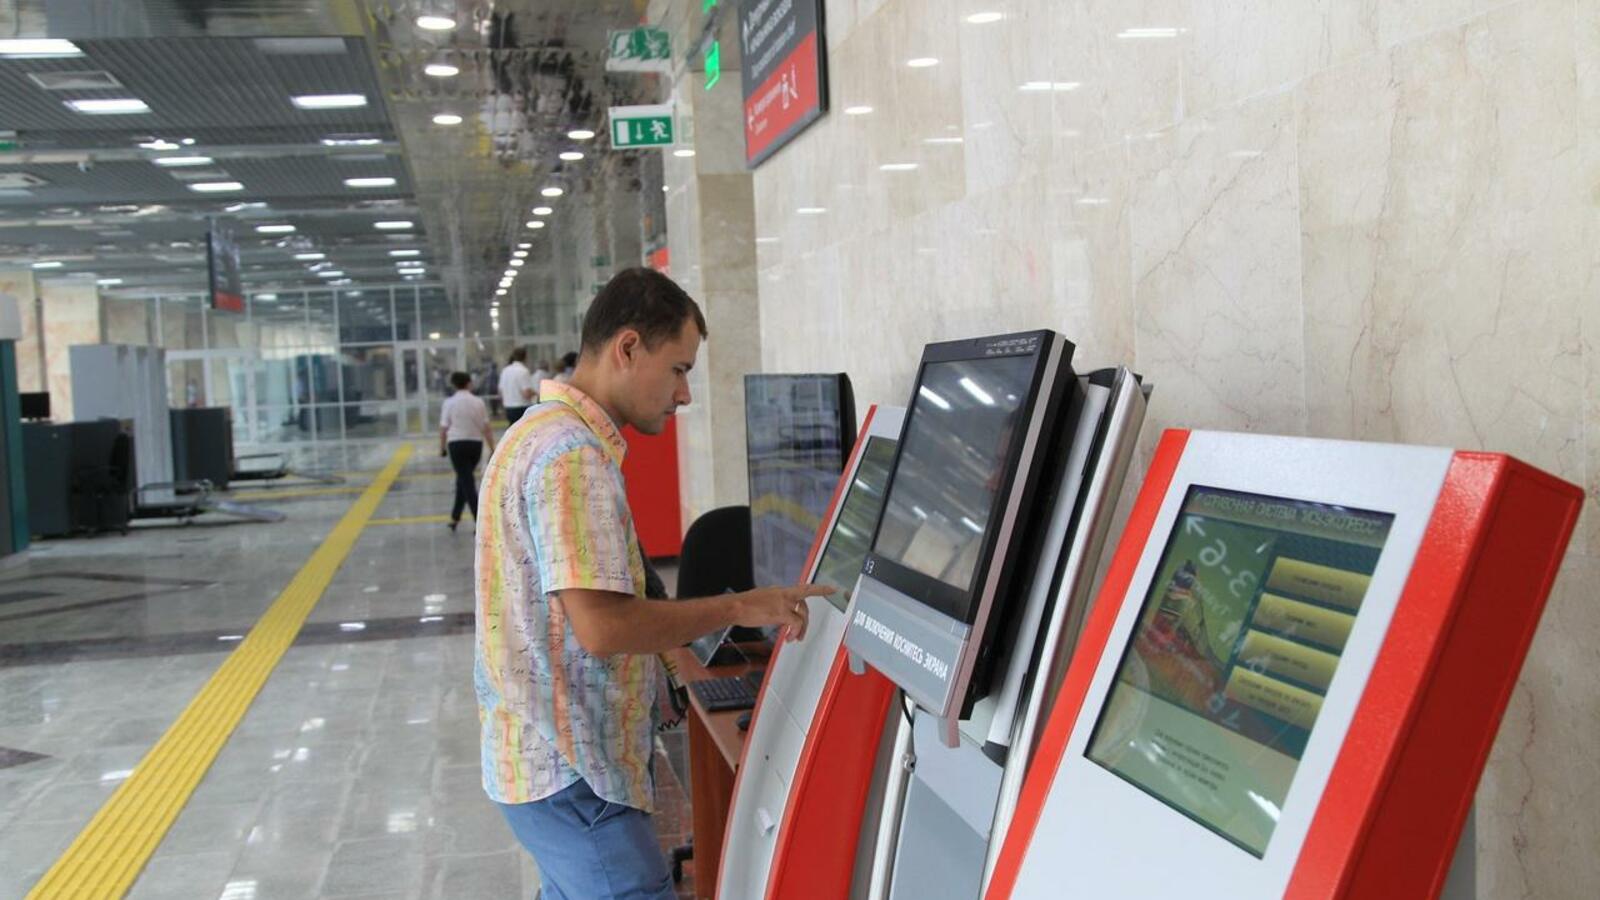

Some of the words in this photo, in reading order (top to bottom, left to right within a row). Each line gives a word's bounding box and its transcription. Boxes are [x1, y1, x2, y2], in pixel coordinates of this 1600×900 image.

[853, 610, 866, 627] ДЛЯ
[864, 615, 895, 645] ВКЛЮЧЕНИЯ
[893, 634, 924, 664] КОСНИТЕСЬ
[923, 652, 949, 681] ЭКРАНА
